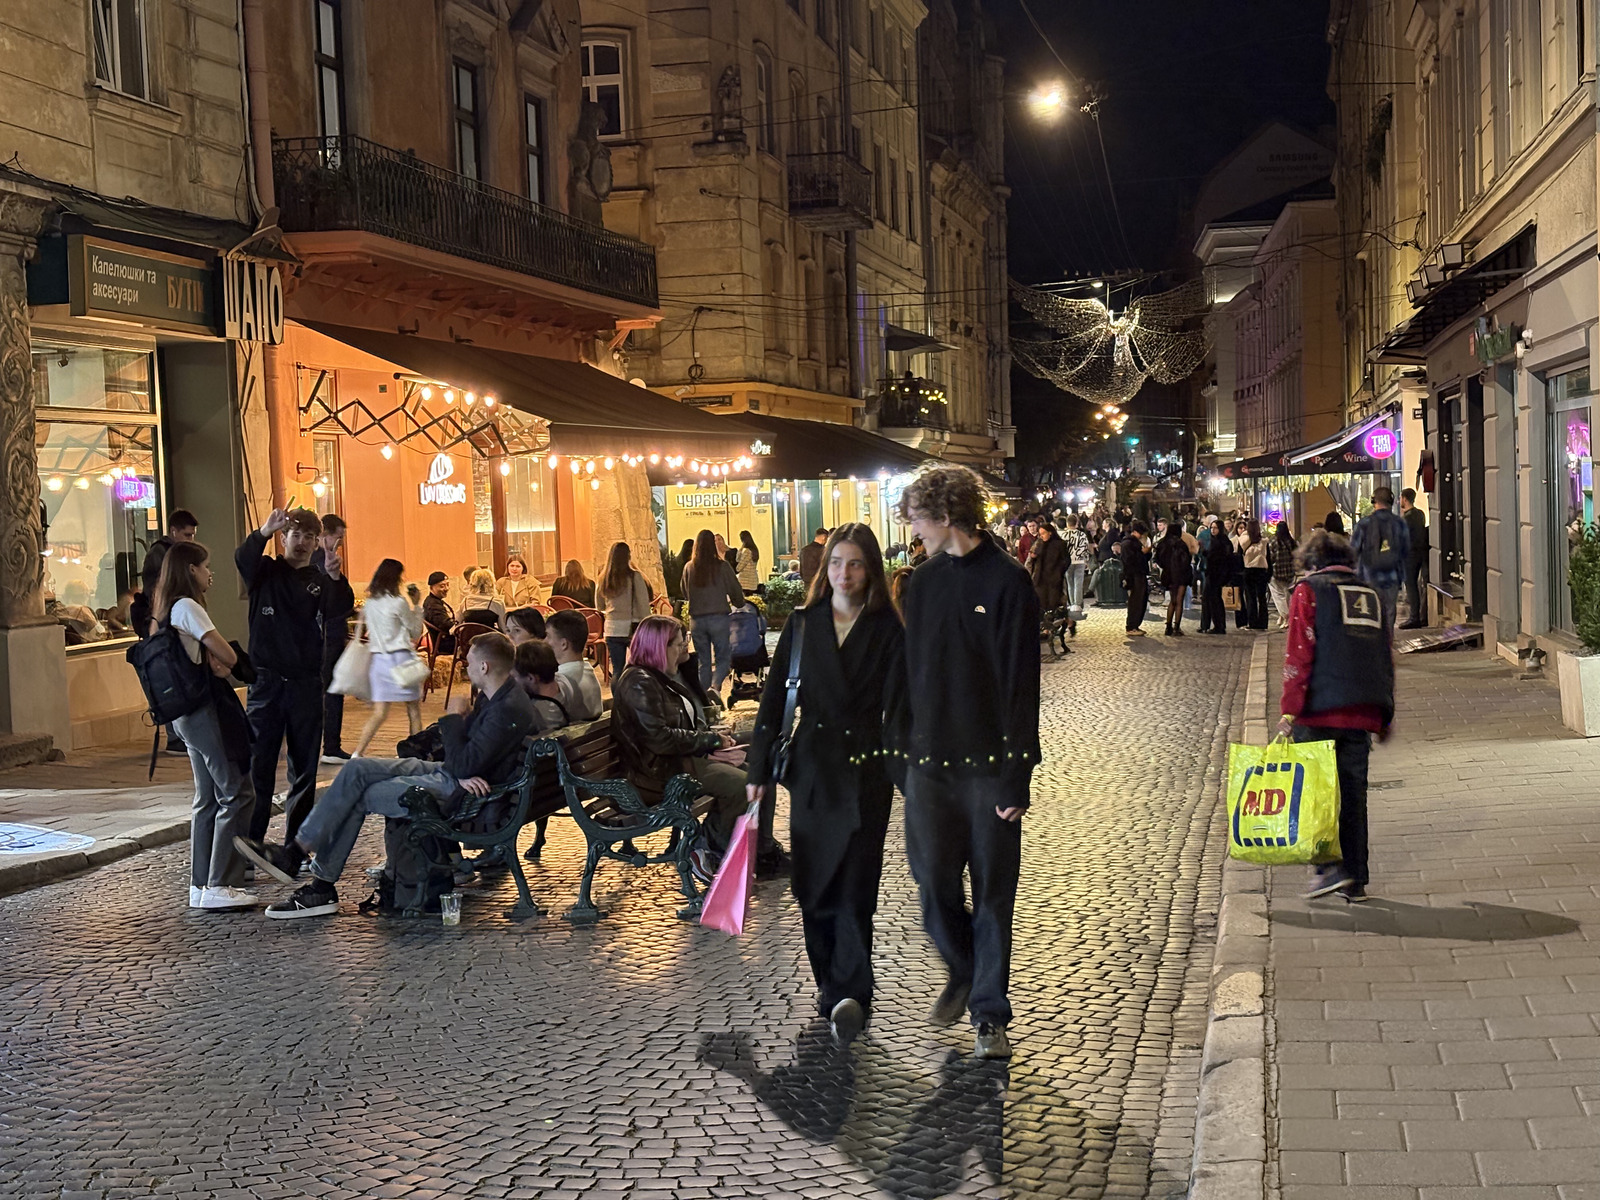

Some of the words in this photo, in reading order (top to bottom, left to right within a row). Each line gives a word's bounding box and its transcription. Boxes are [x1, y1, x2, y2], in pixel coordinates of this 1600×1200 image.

[1269, 153, 1318, 162] SAMSUNG
[92, 255, 145, 282] Капелюшки
[146, 270, 157, 284] та
[92, 282, 139, 306] аксесуари
[225, 258, 284, 344] ШАПО
[1371, 434, 1390, 445] TIKI
[1343, 454, 1368, 464] Wine
[1352, 593, 1371, 615] 4
[1242, 788, 1286, 817] MD
